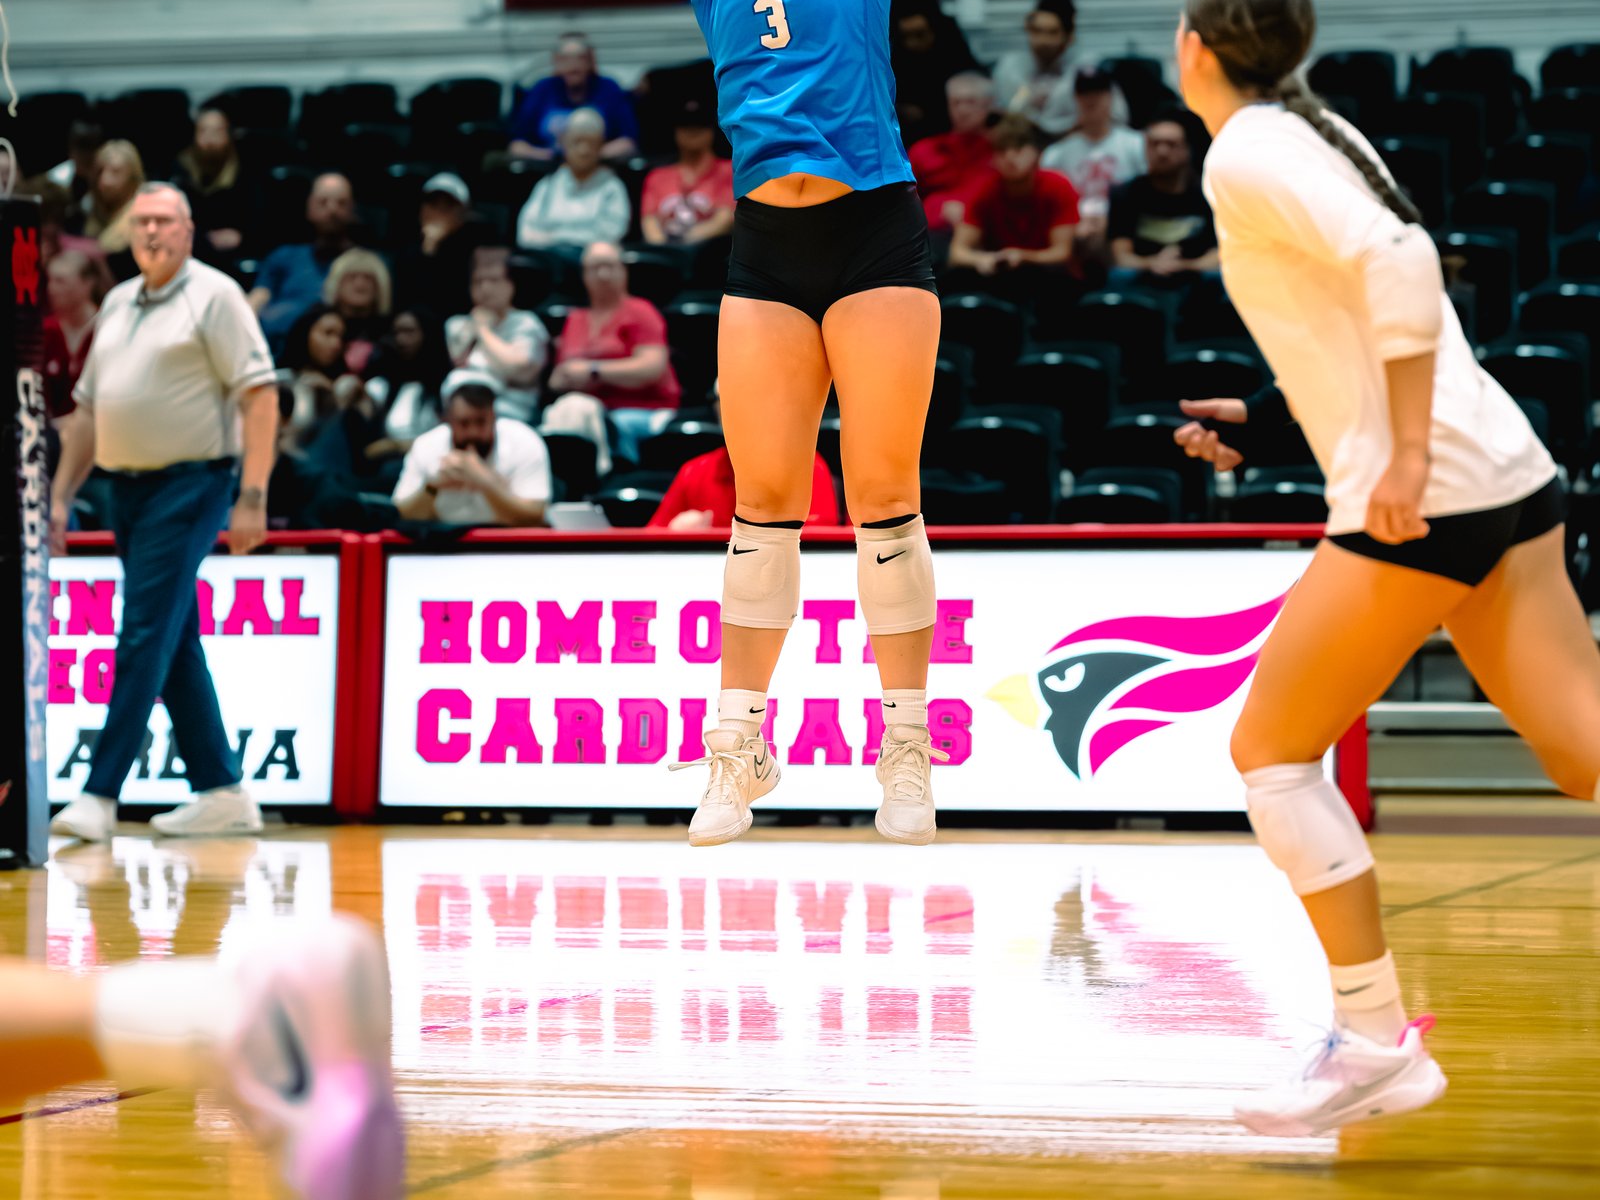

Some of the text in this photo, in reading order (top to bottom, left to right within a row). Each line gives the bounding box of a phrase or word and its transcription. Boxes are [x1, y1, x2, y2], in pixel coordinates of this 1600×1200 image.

[420, 600, 657, 664] HOME
[803, 600, 973, 664] TE
[416, 689, 973, 766] CARDIAS
